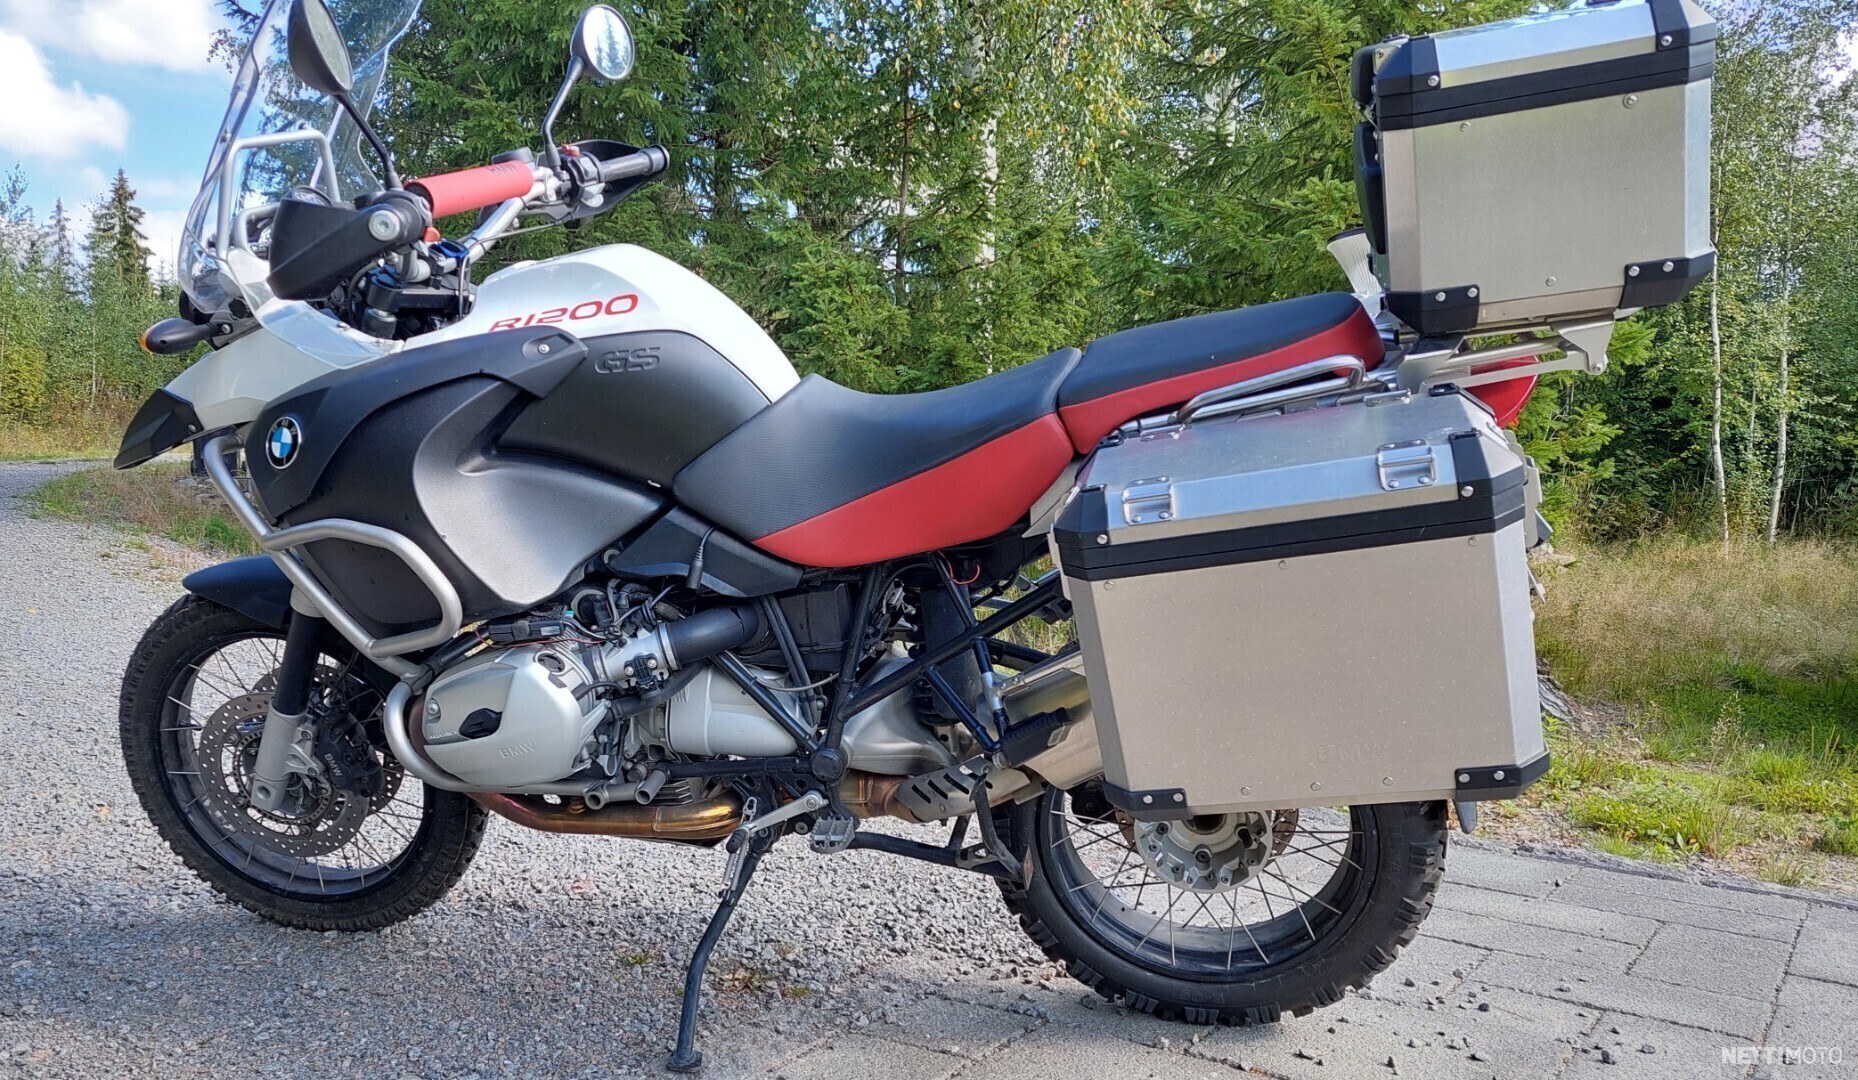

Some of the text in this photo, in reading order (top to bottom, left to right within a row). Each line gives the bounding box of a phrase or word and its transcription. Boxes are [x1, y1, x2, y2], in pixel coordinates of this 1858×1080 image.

[595, 347, 661, 374] GS
[270, 418, 297, 437] BMW
[497, 741, 535, 760] BMW
[324, 753, 343, 776] BMW
